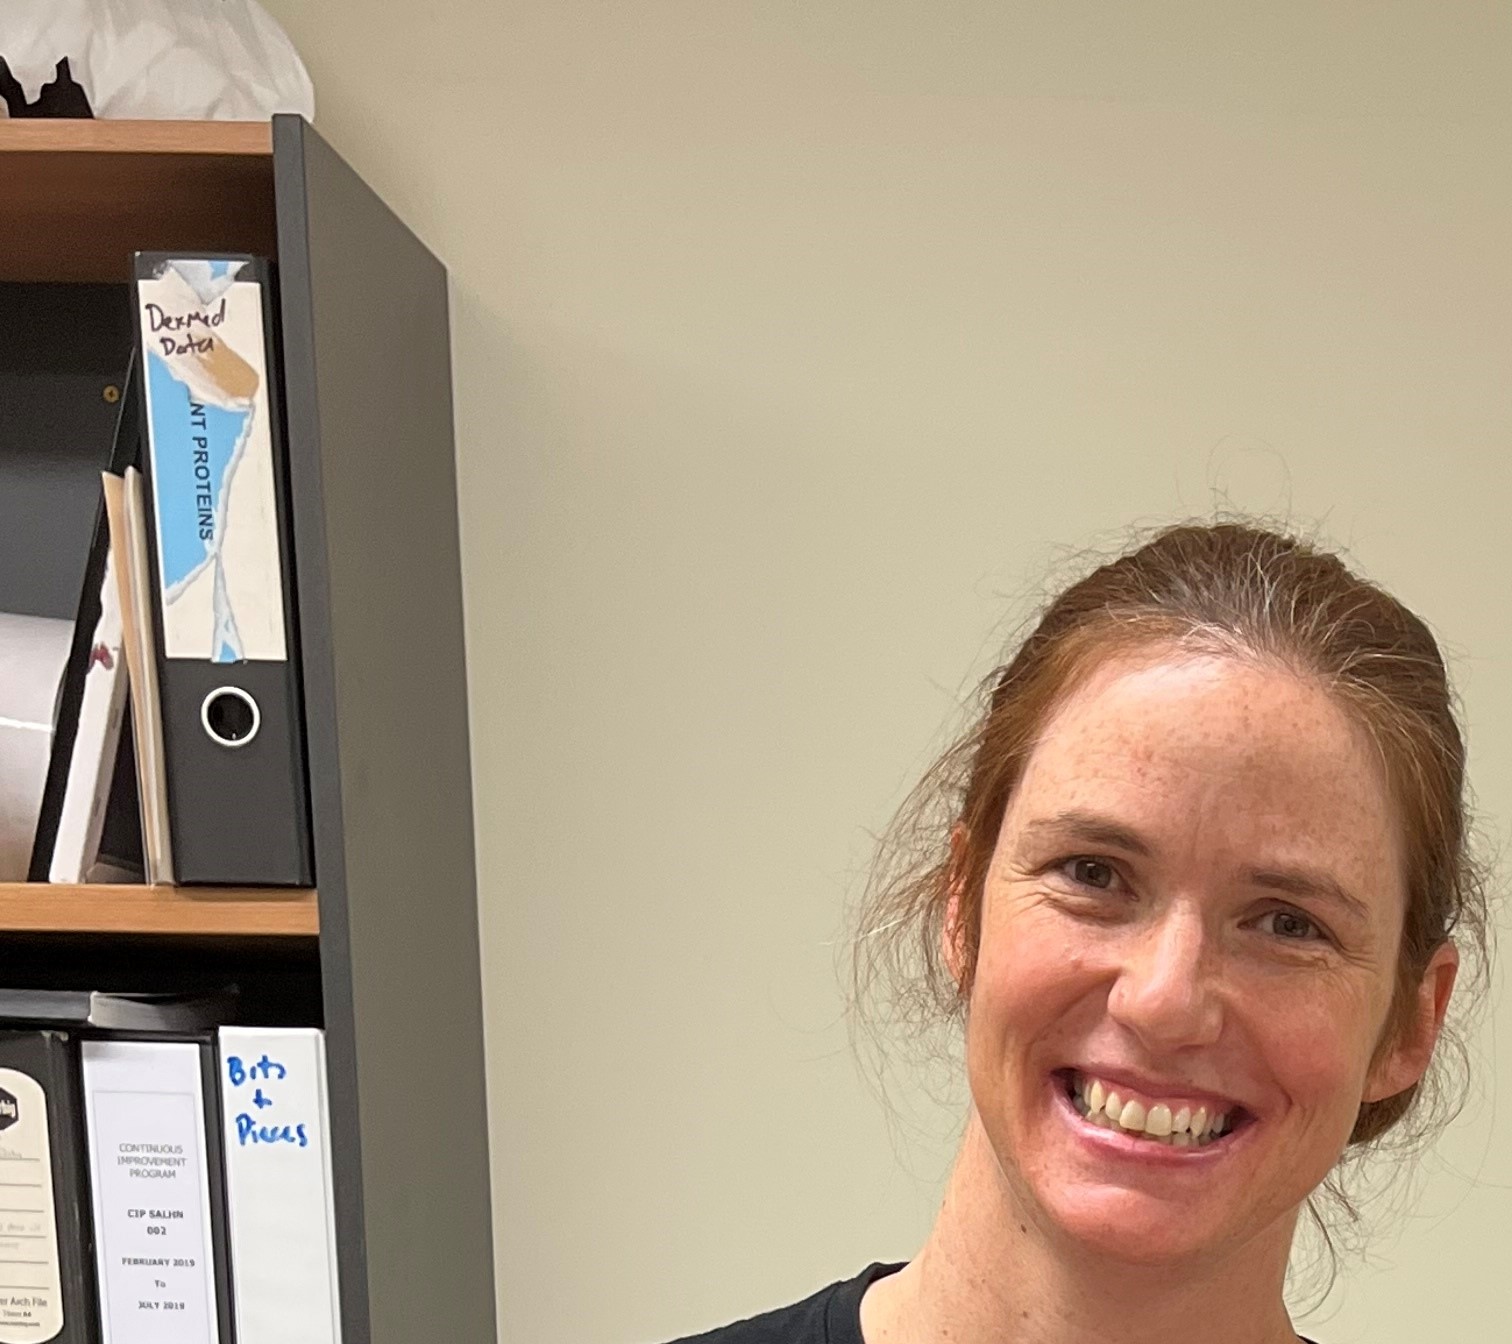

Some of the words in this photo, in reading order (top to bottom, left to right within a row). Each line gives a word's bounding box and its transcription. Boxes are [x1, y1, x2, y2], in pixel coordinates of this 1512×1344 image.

[160, 333, 215, 356] Data
[192, 436, 214, 541] PROTEINS
[227, 1054, 287, 1086] Bits
[235, 1112, 308, 1147] Pieces
[119, 1143, 183, 1154] CONTINUOUS
[117, 1156, 186, 1167] IMPROVEMENT
[129, 1168, 176, 1179] PROGRAM
[127, 1209, 146, 1219] CIP
[149, 1209, 184, 1219] SALHN
[121, 1257, 170, 1267] FEBRUARY
[138, 1301, 159, 1310] JULY
